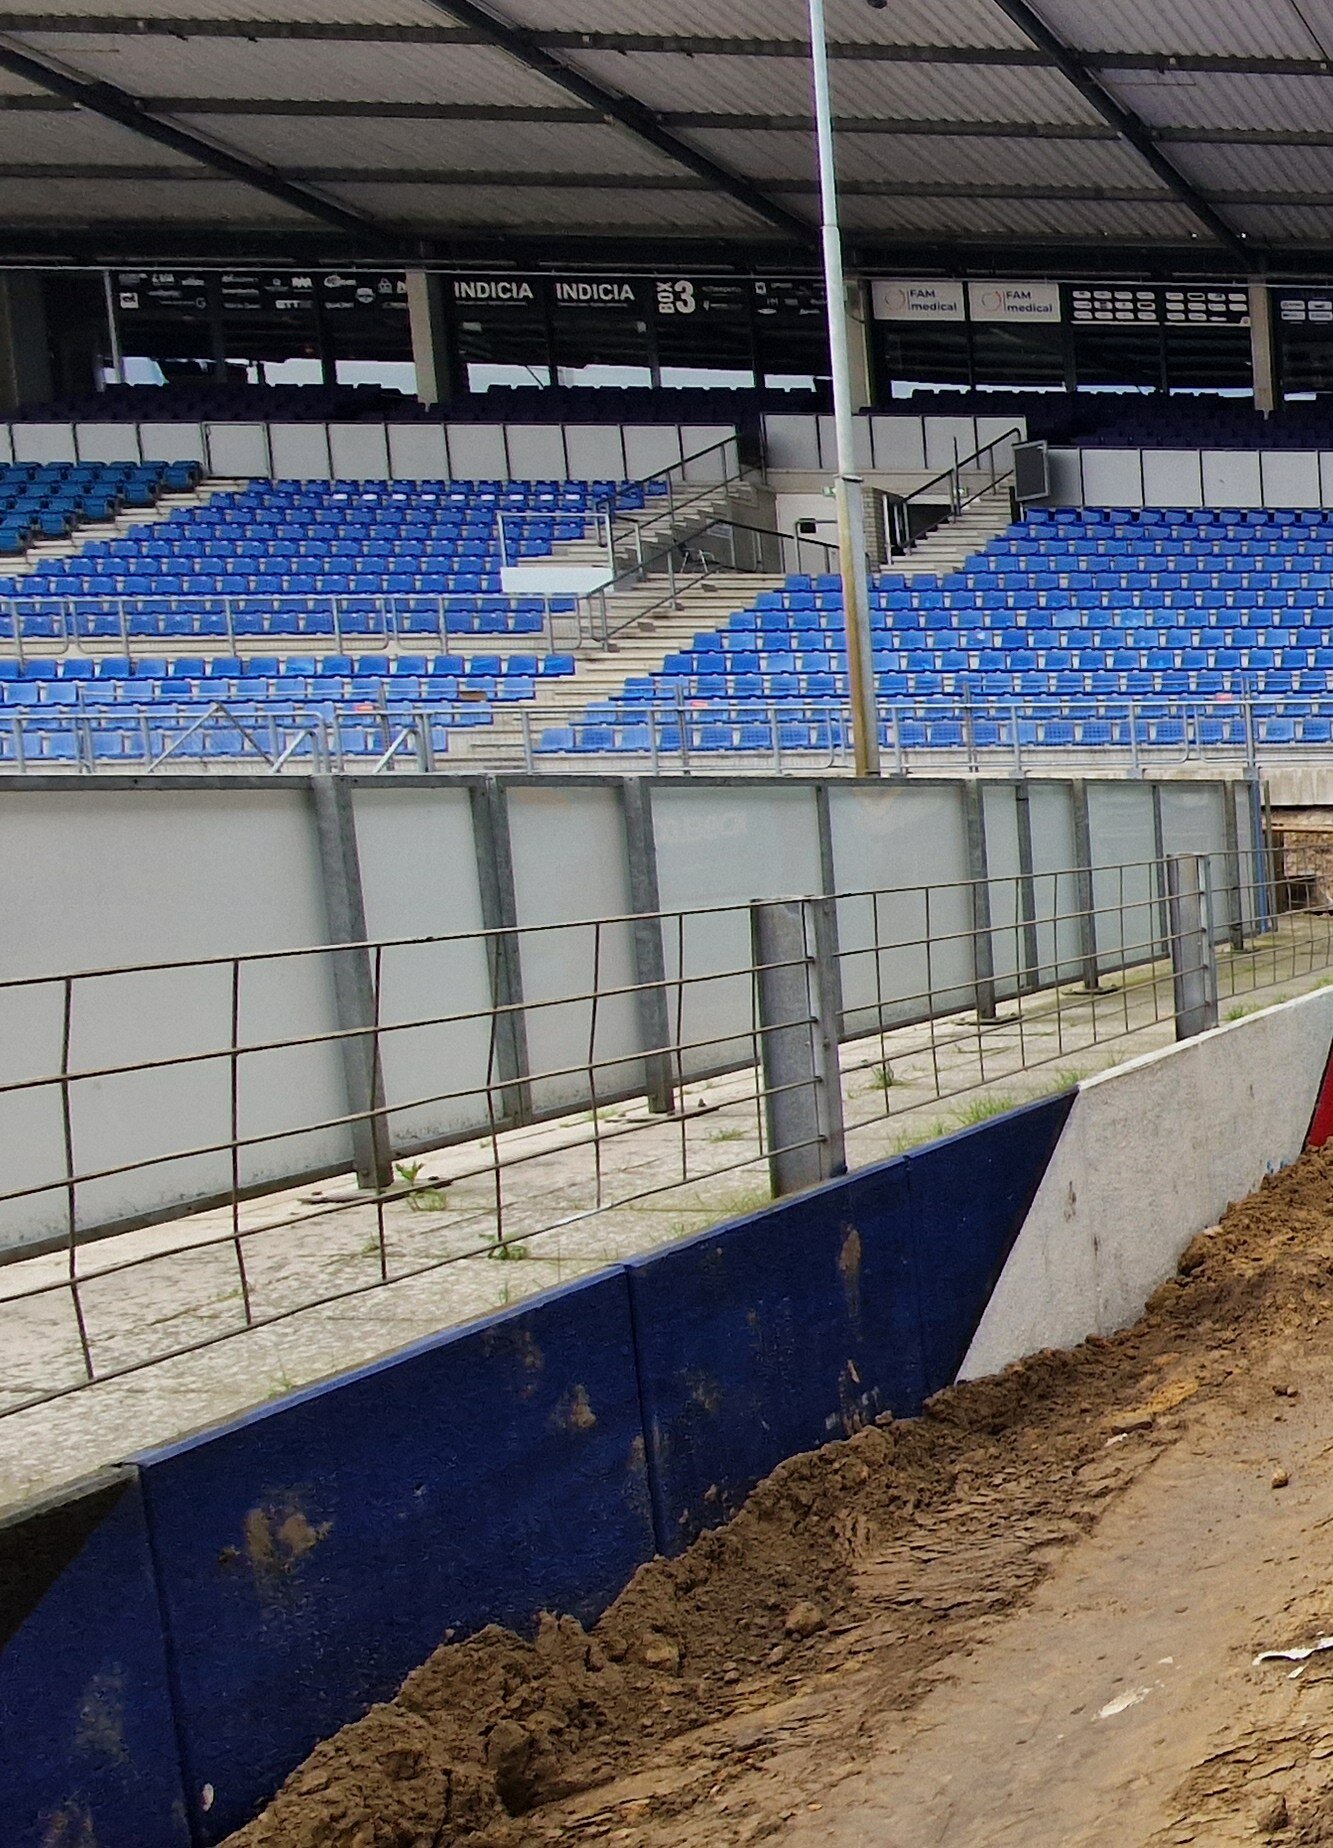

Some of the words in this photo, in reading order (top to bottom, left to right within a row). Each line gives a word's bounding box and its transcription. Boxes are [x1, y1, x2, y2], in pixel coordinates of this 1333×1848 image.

[453, 281, 534, 299] INDICIA
[556, 283, 635, 300] INDICIA
[910, 289, 936, 298] FAM
[656, 282, 676, 314] BOX
[674, 280, 696, 314] 3
[1006, 291, 1031, 300] FAM
[911, 302, 957, 312] medical
[1007, 304, 1052, 313] medical
